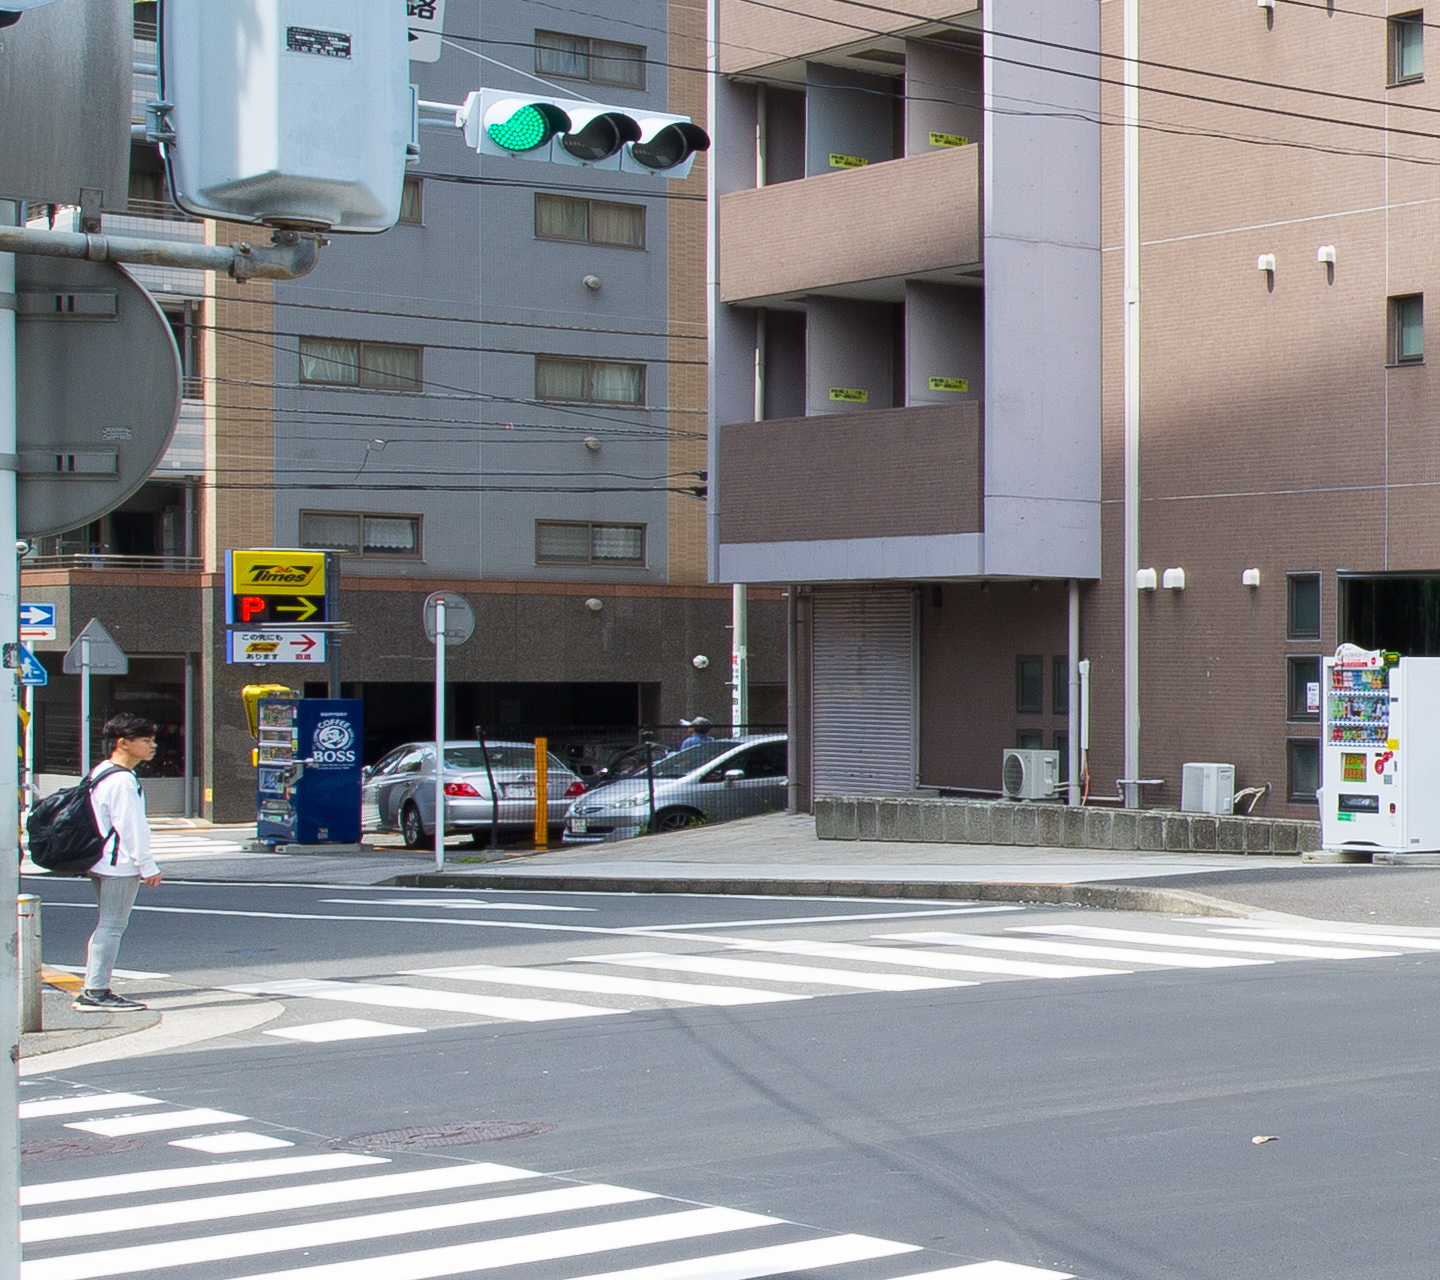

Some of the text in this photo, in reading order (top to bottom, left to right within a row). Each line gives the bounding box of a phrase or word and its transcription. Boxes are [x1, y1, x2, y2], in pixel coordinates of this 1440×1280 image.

[249, 565, 308, 582] Times
[242, 596, 265, 622] P
[241, 633, 283, 641] この先にも
[317, 718, 351, 729] COFFEE
[313, 750, 356, 763] BOSS
